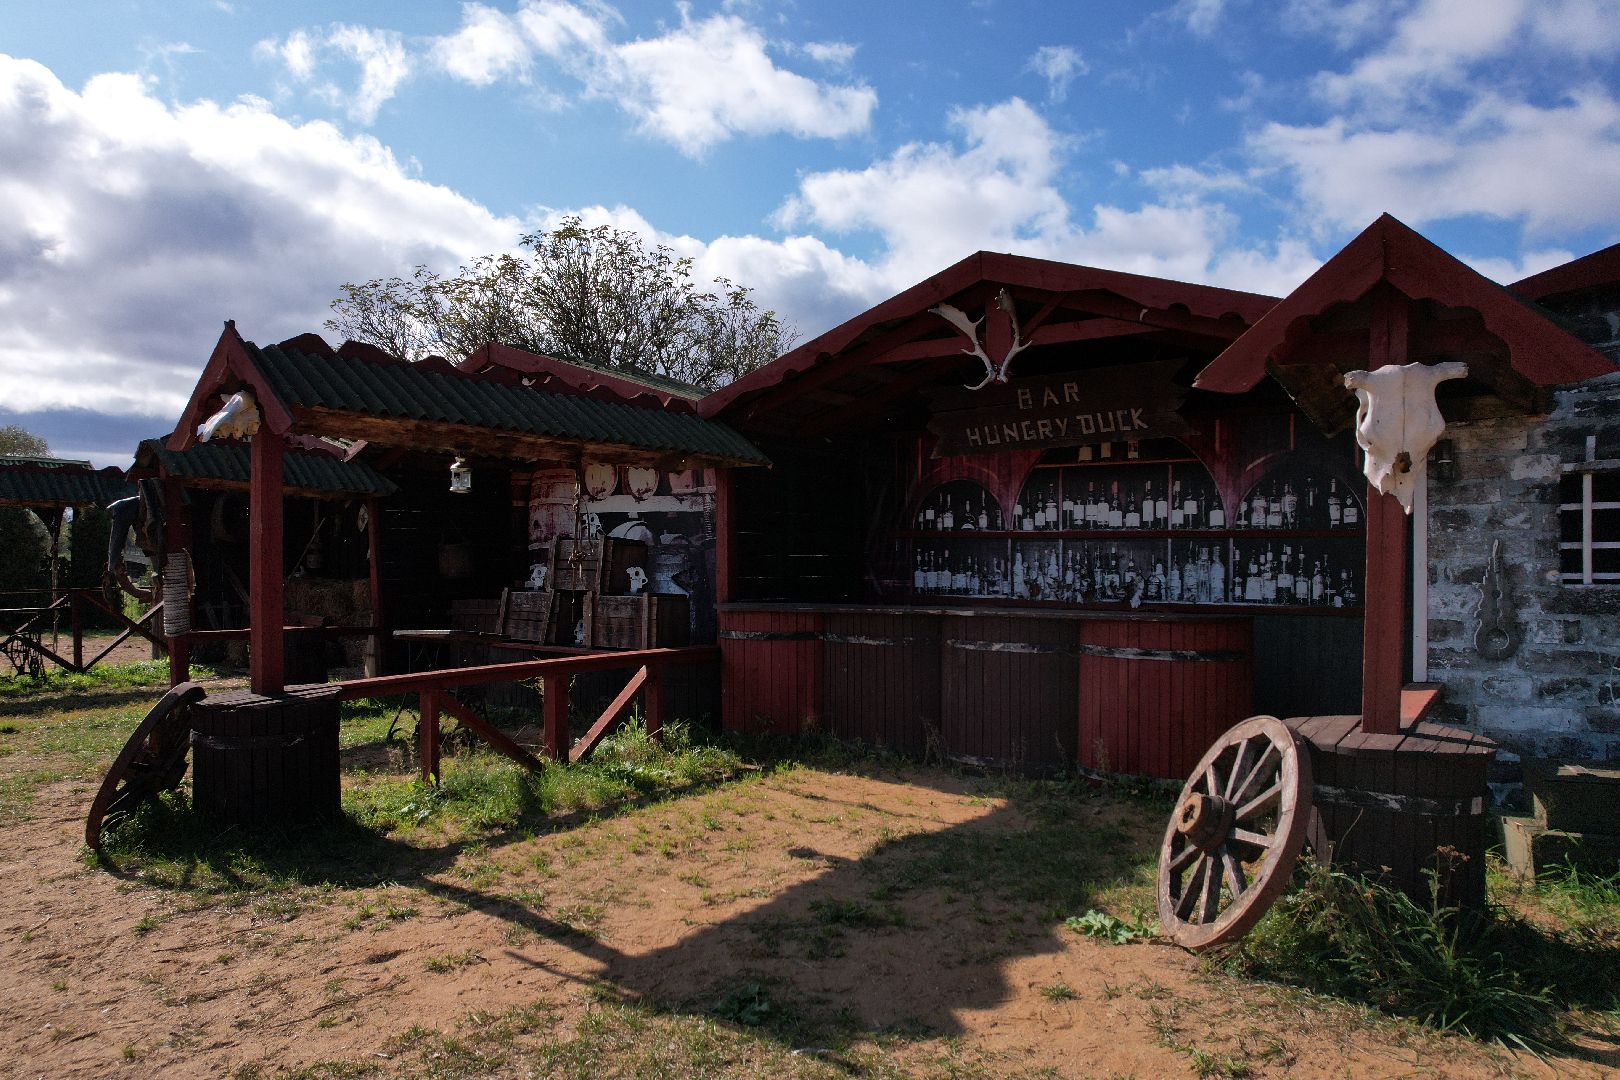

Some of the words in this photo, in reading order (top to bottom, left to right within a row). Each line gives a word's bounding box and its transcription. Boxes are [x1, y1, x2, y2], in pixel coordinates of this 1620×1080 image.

[1017, 381, 1080, 410] BAR
[966, 417, 1068, 447] HUNGRY
[1076, 407, 1149, 435] DUCK
